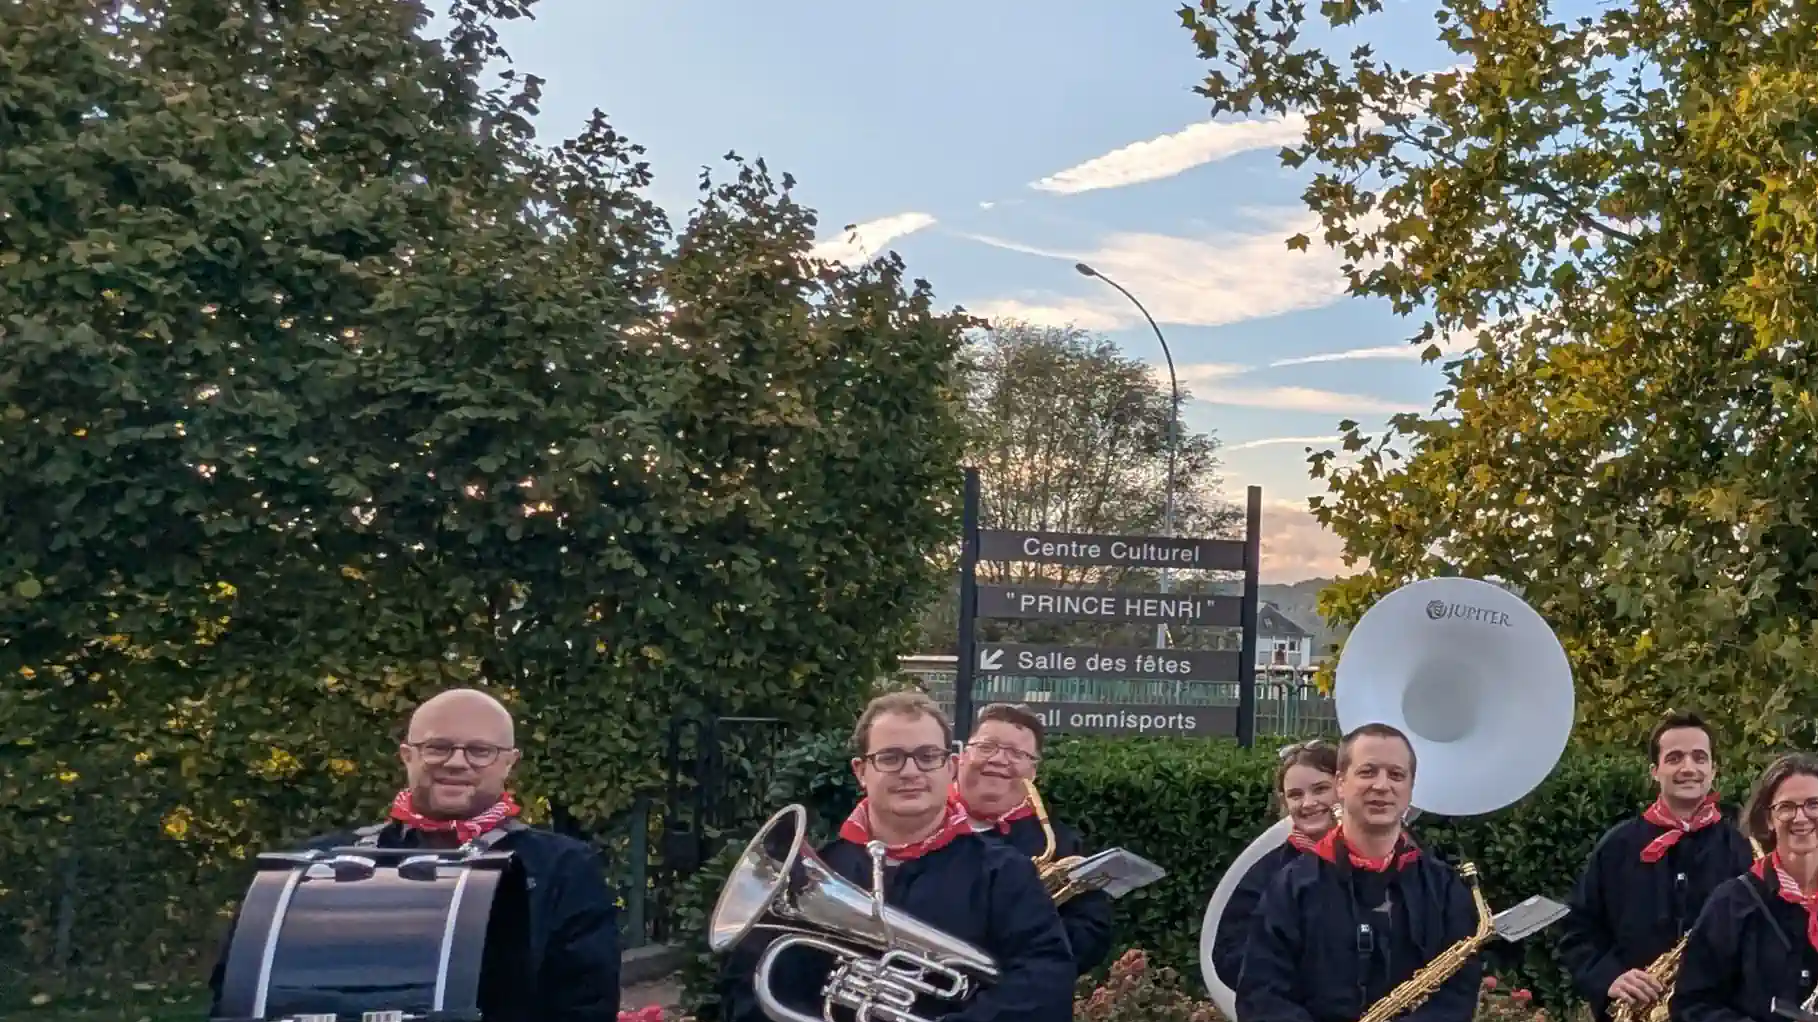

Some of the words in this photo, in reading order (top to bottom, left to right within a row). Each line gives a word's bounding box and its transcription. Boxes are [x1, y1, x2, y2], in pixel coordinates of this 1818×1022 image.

[1023, 538, 1100, 558] Centre
[1110, 541, 1200, 562] Culturel
[1447, 603, 1513, 627] JUPITER
[1017, 652, 1077, 671] Salle
[1086, 654, 1126, 672] des
[1135, 655, 1192, 674] fêtes
[1070, 710, 1197, 732] omnisports
